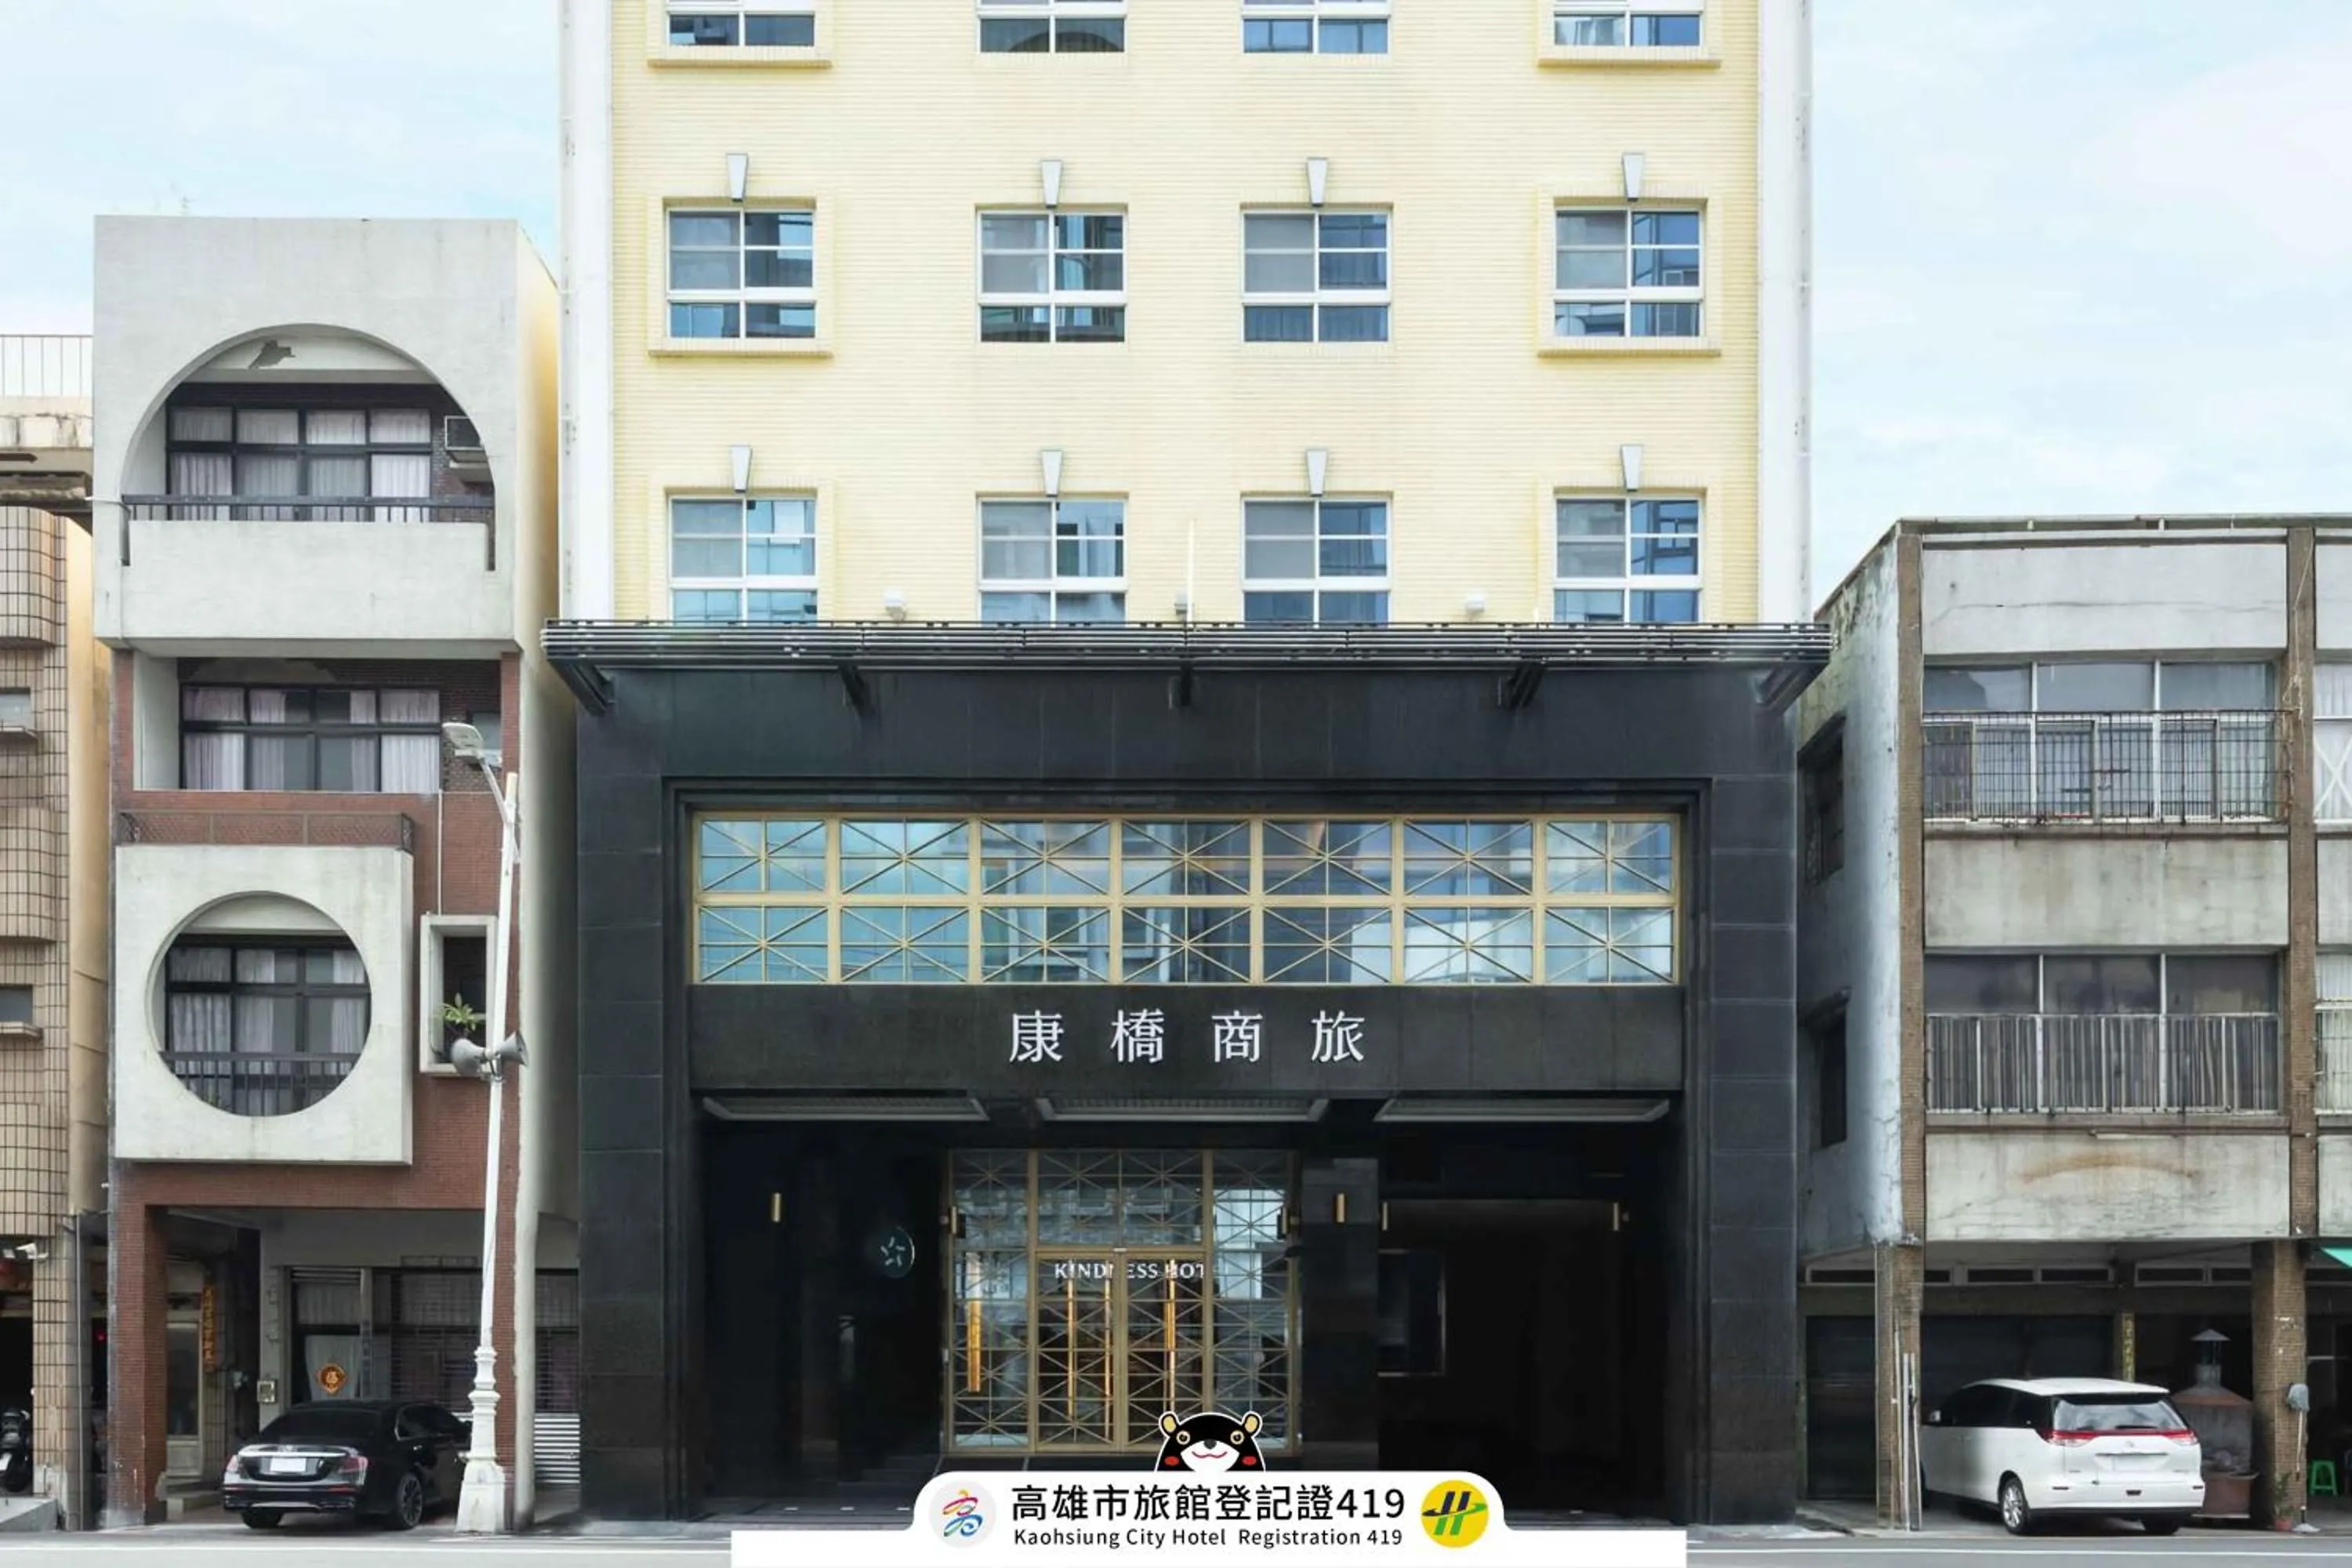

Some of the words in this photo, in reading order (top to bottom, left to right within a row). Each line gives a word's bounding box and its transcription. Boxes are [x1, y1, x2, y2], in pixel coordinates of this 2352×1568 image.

[1008, 1008, 1366, 1063] 康橋商旅
[1054, 1262, 1158, 1279] KINDESS
[1165, 1262, 1221, 1279] HOT
